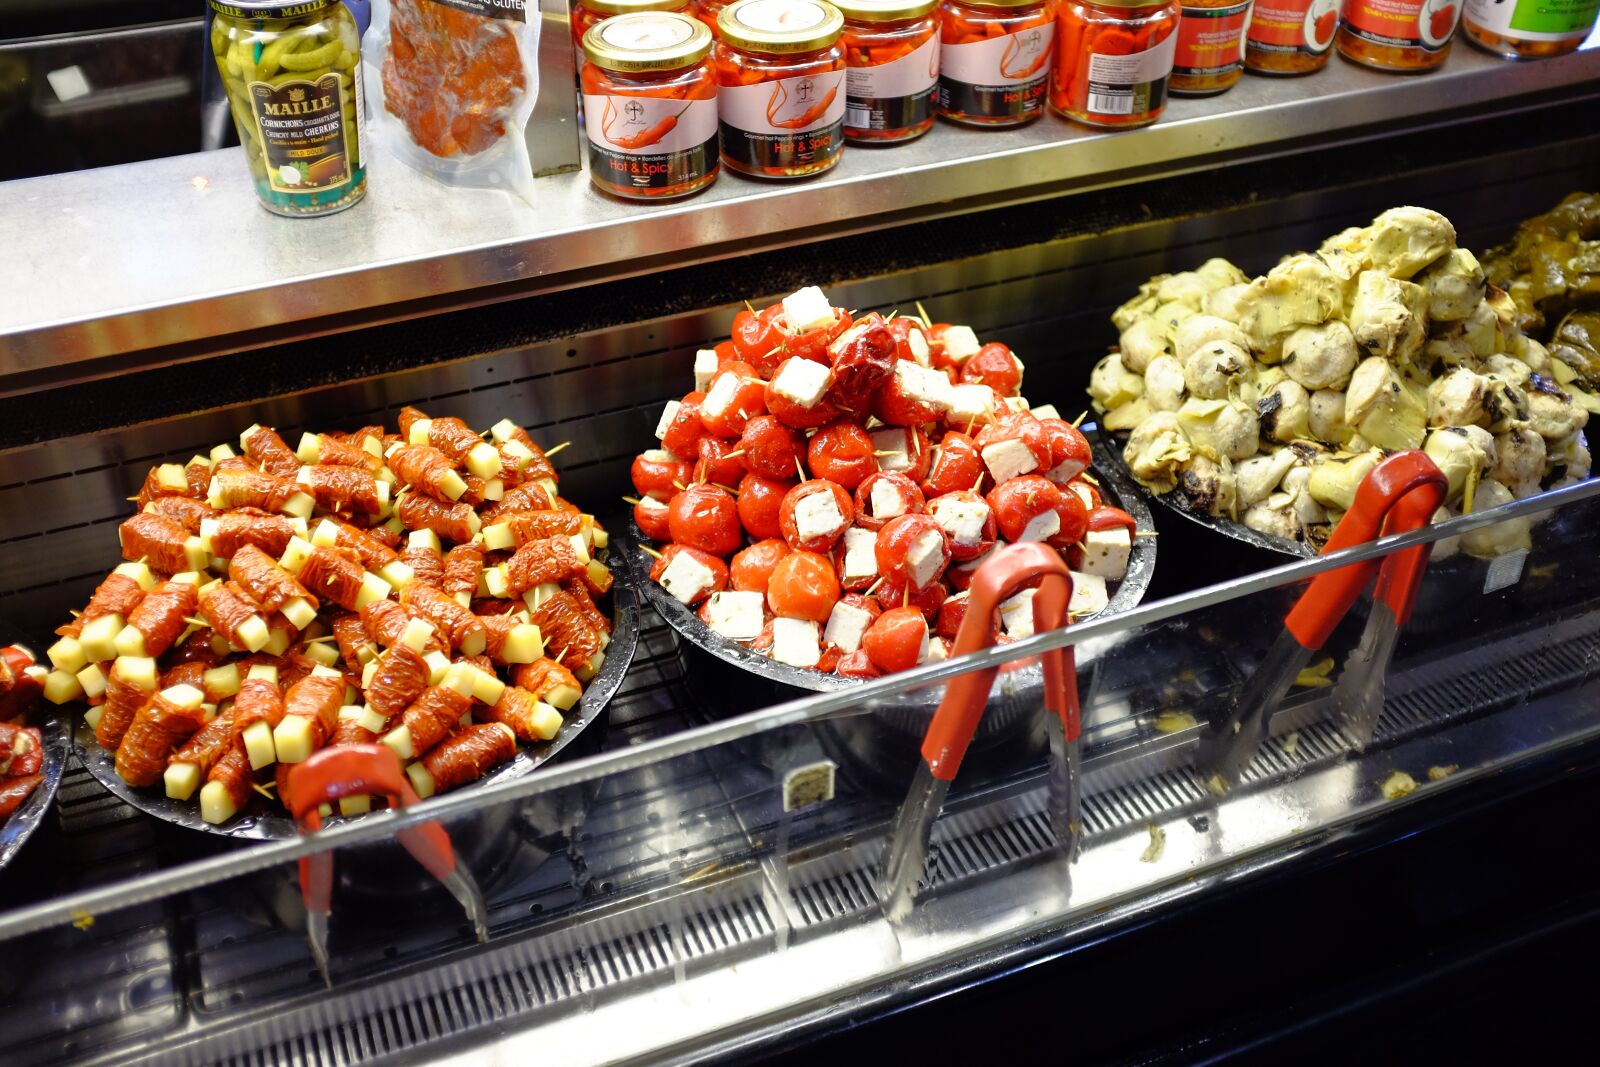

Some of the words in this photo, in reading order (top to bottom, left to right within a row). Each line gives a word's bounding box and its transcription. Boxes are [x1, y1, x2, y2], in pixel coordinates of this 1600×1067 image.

[281, 1, 325, 17] MAILLE
[260, 116, 304, 128] CORNICHONS
[304, 120, 340, 137] GHERKINS
[774, 143, 795, 153] Hot
[610, 158, 628, 172] Hot
[630, 162, 639, 173] &
[641, 162, 673, 175] Spicy
